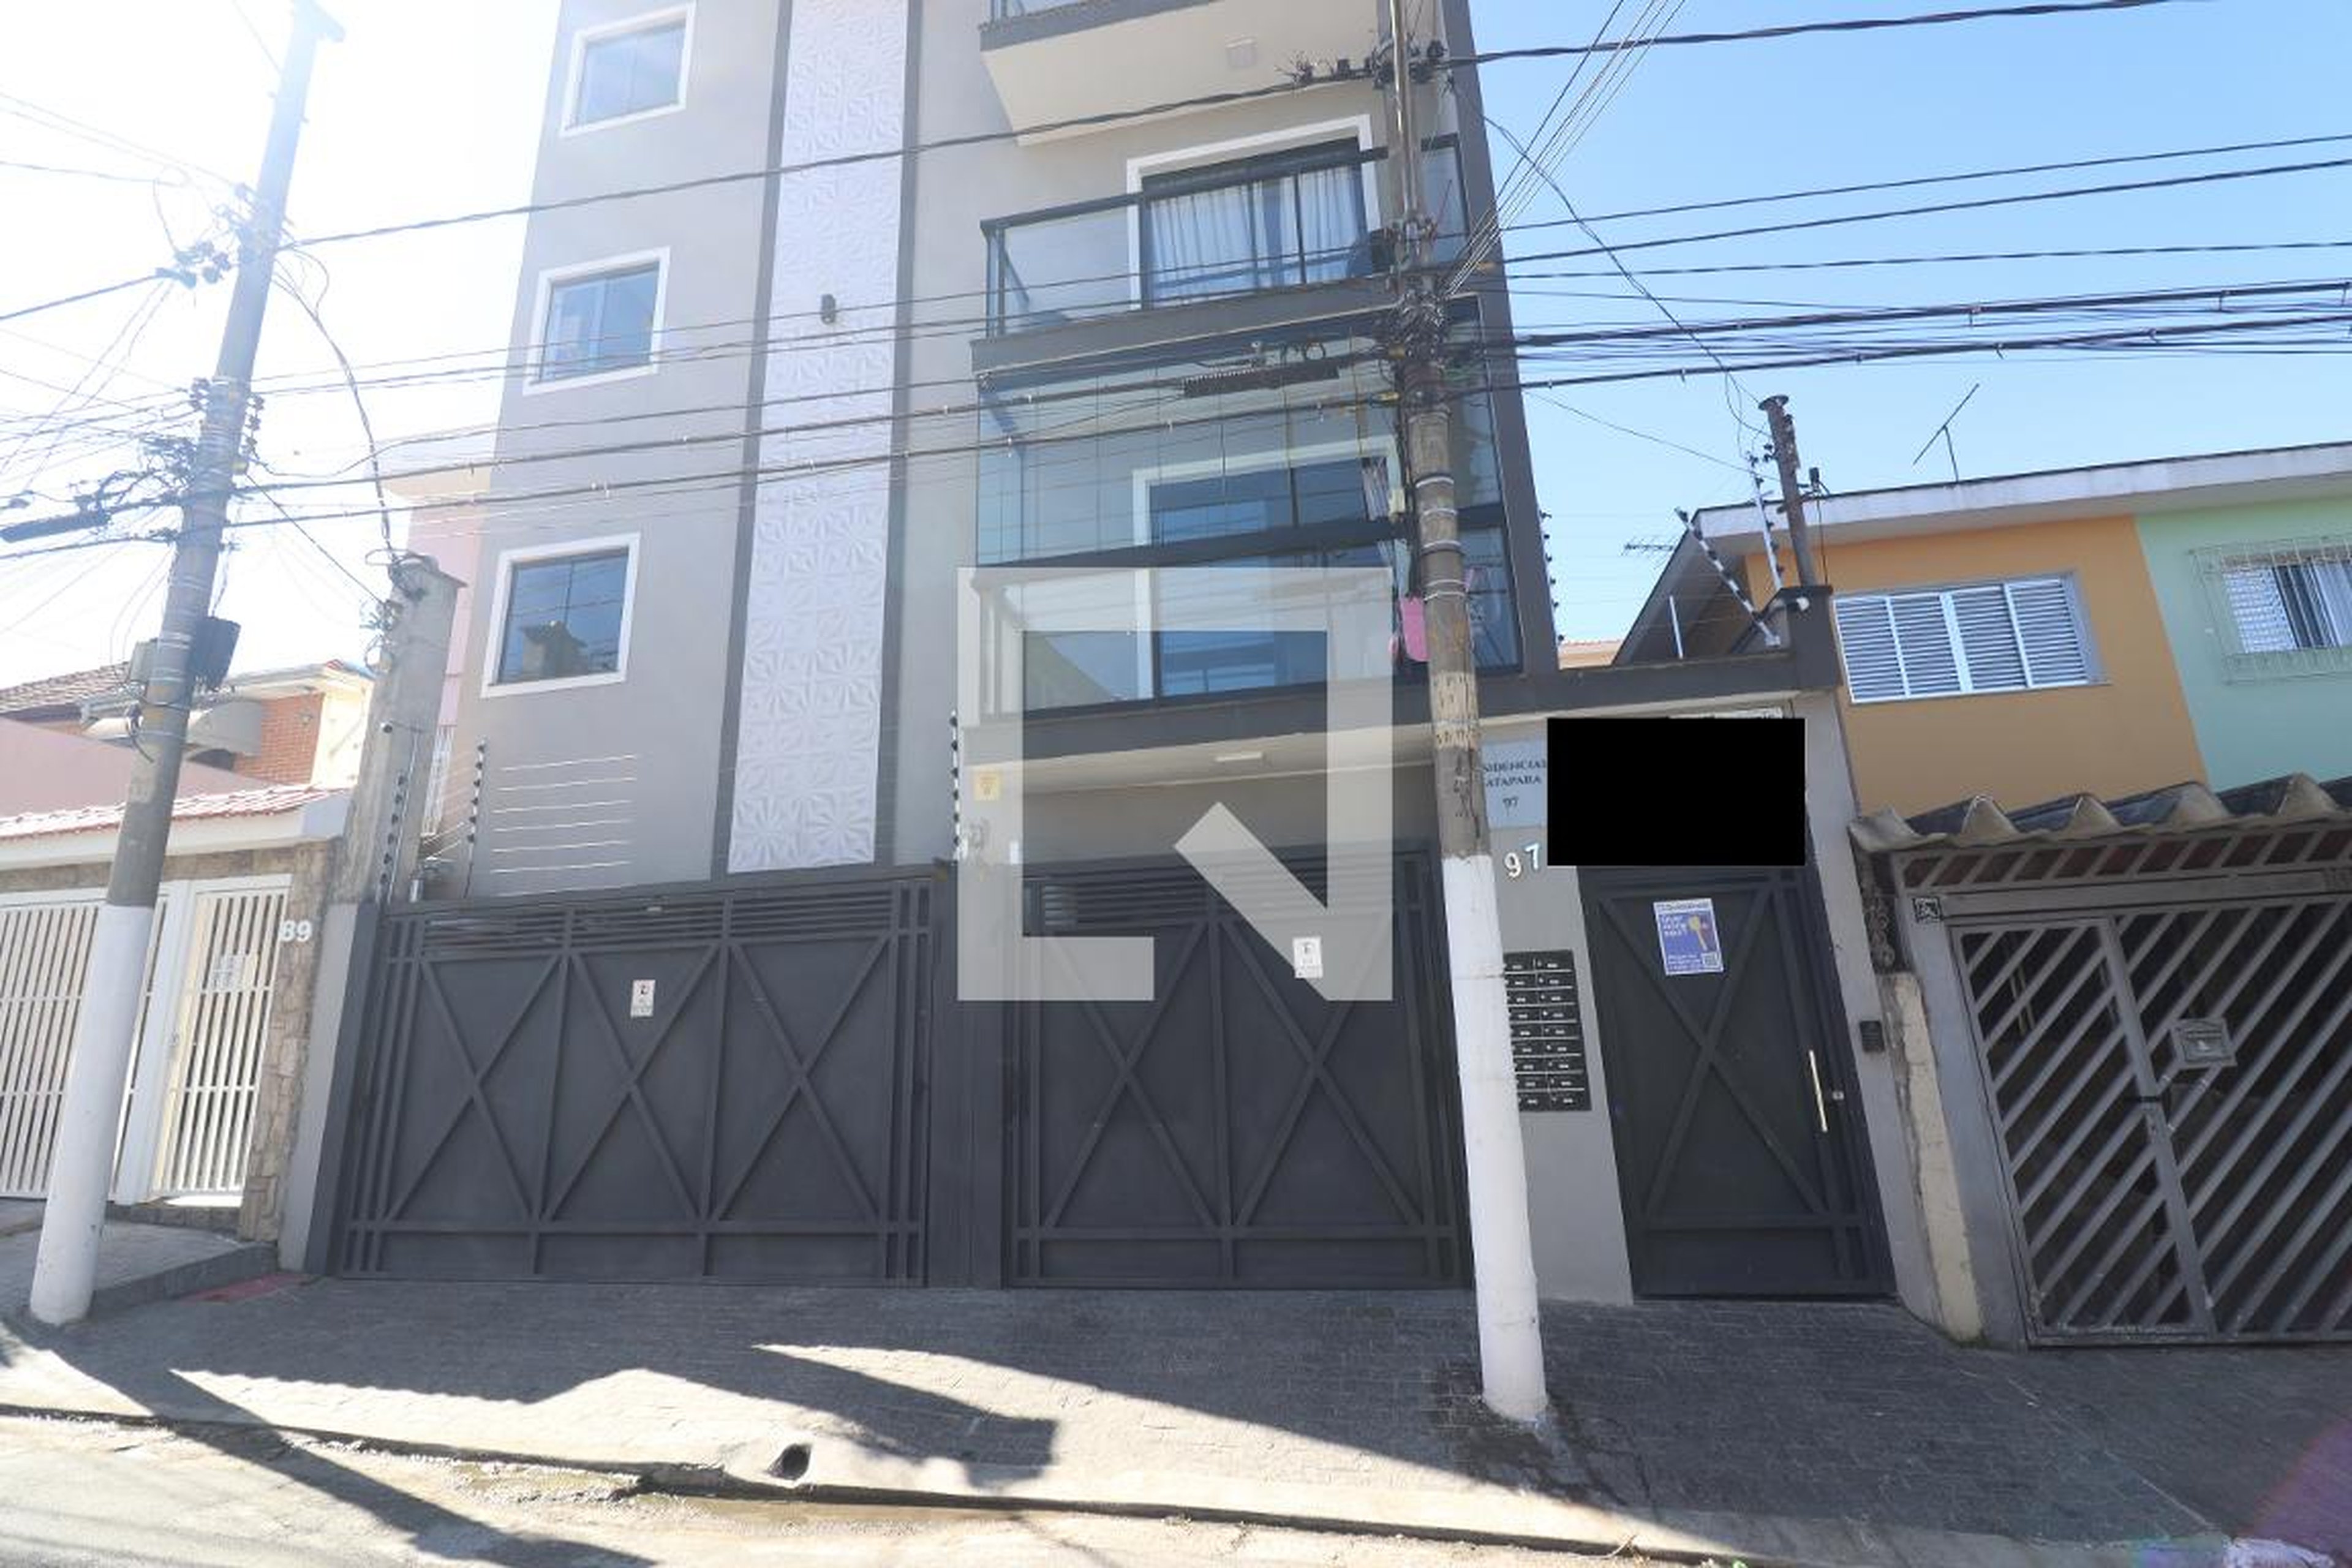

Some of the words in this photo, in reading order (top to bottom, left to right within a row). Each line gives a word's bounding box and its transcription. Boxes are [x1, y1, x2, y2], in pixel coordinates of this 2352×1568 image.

[1486, 775, 1542, 787] ATAPARA
[1504, 843, 1539, 877] 97
[280, 920, 312, 942] 89
